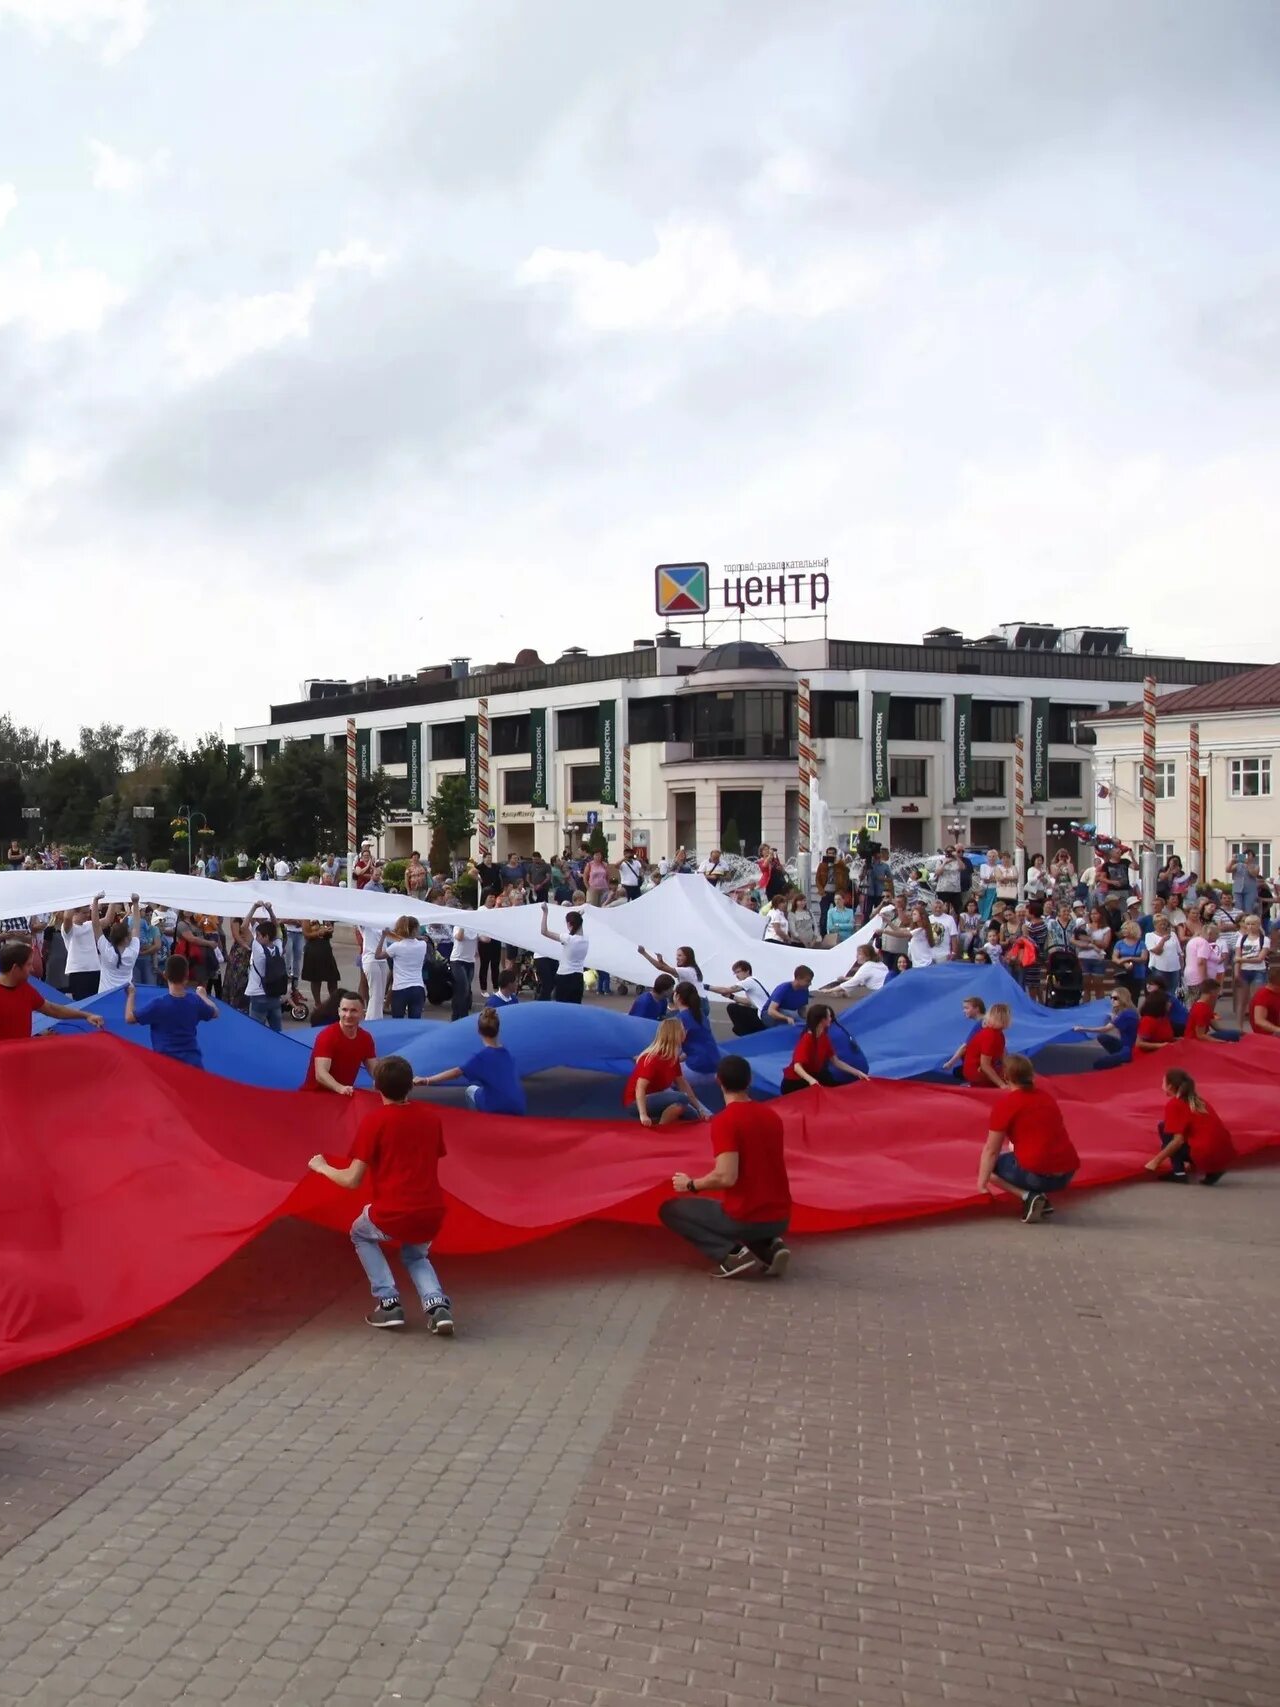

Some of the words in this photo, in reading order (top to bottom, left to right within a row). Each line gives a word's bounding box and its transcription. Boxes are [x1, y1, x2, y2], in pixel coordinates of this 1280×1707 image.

[724, 572, 829, 613] центр
[410, 739, 418, 795] Перекресток
[469, 733, 477, 791] Перекресток
[535, 726, 543, 788] Перекресток
[603, 719, 612, 785] Перекресток
[874, 712, 884, 780] Перекресток
[958, 714, 967, 781] Перекресток
[1034, 716, 1044, 781] Перекресток
